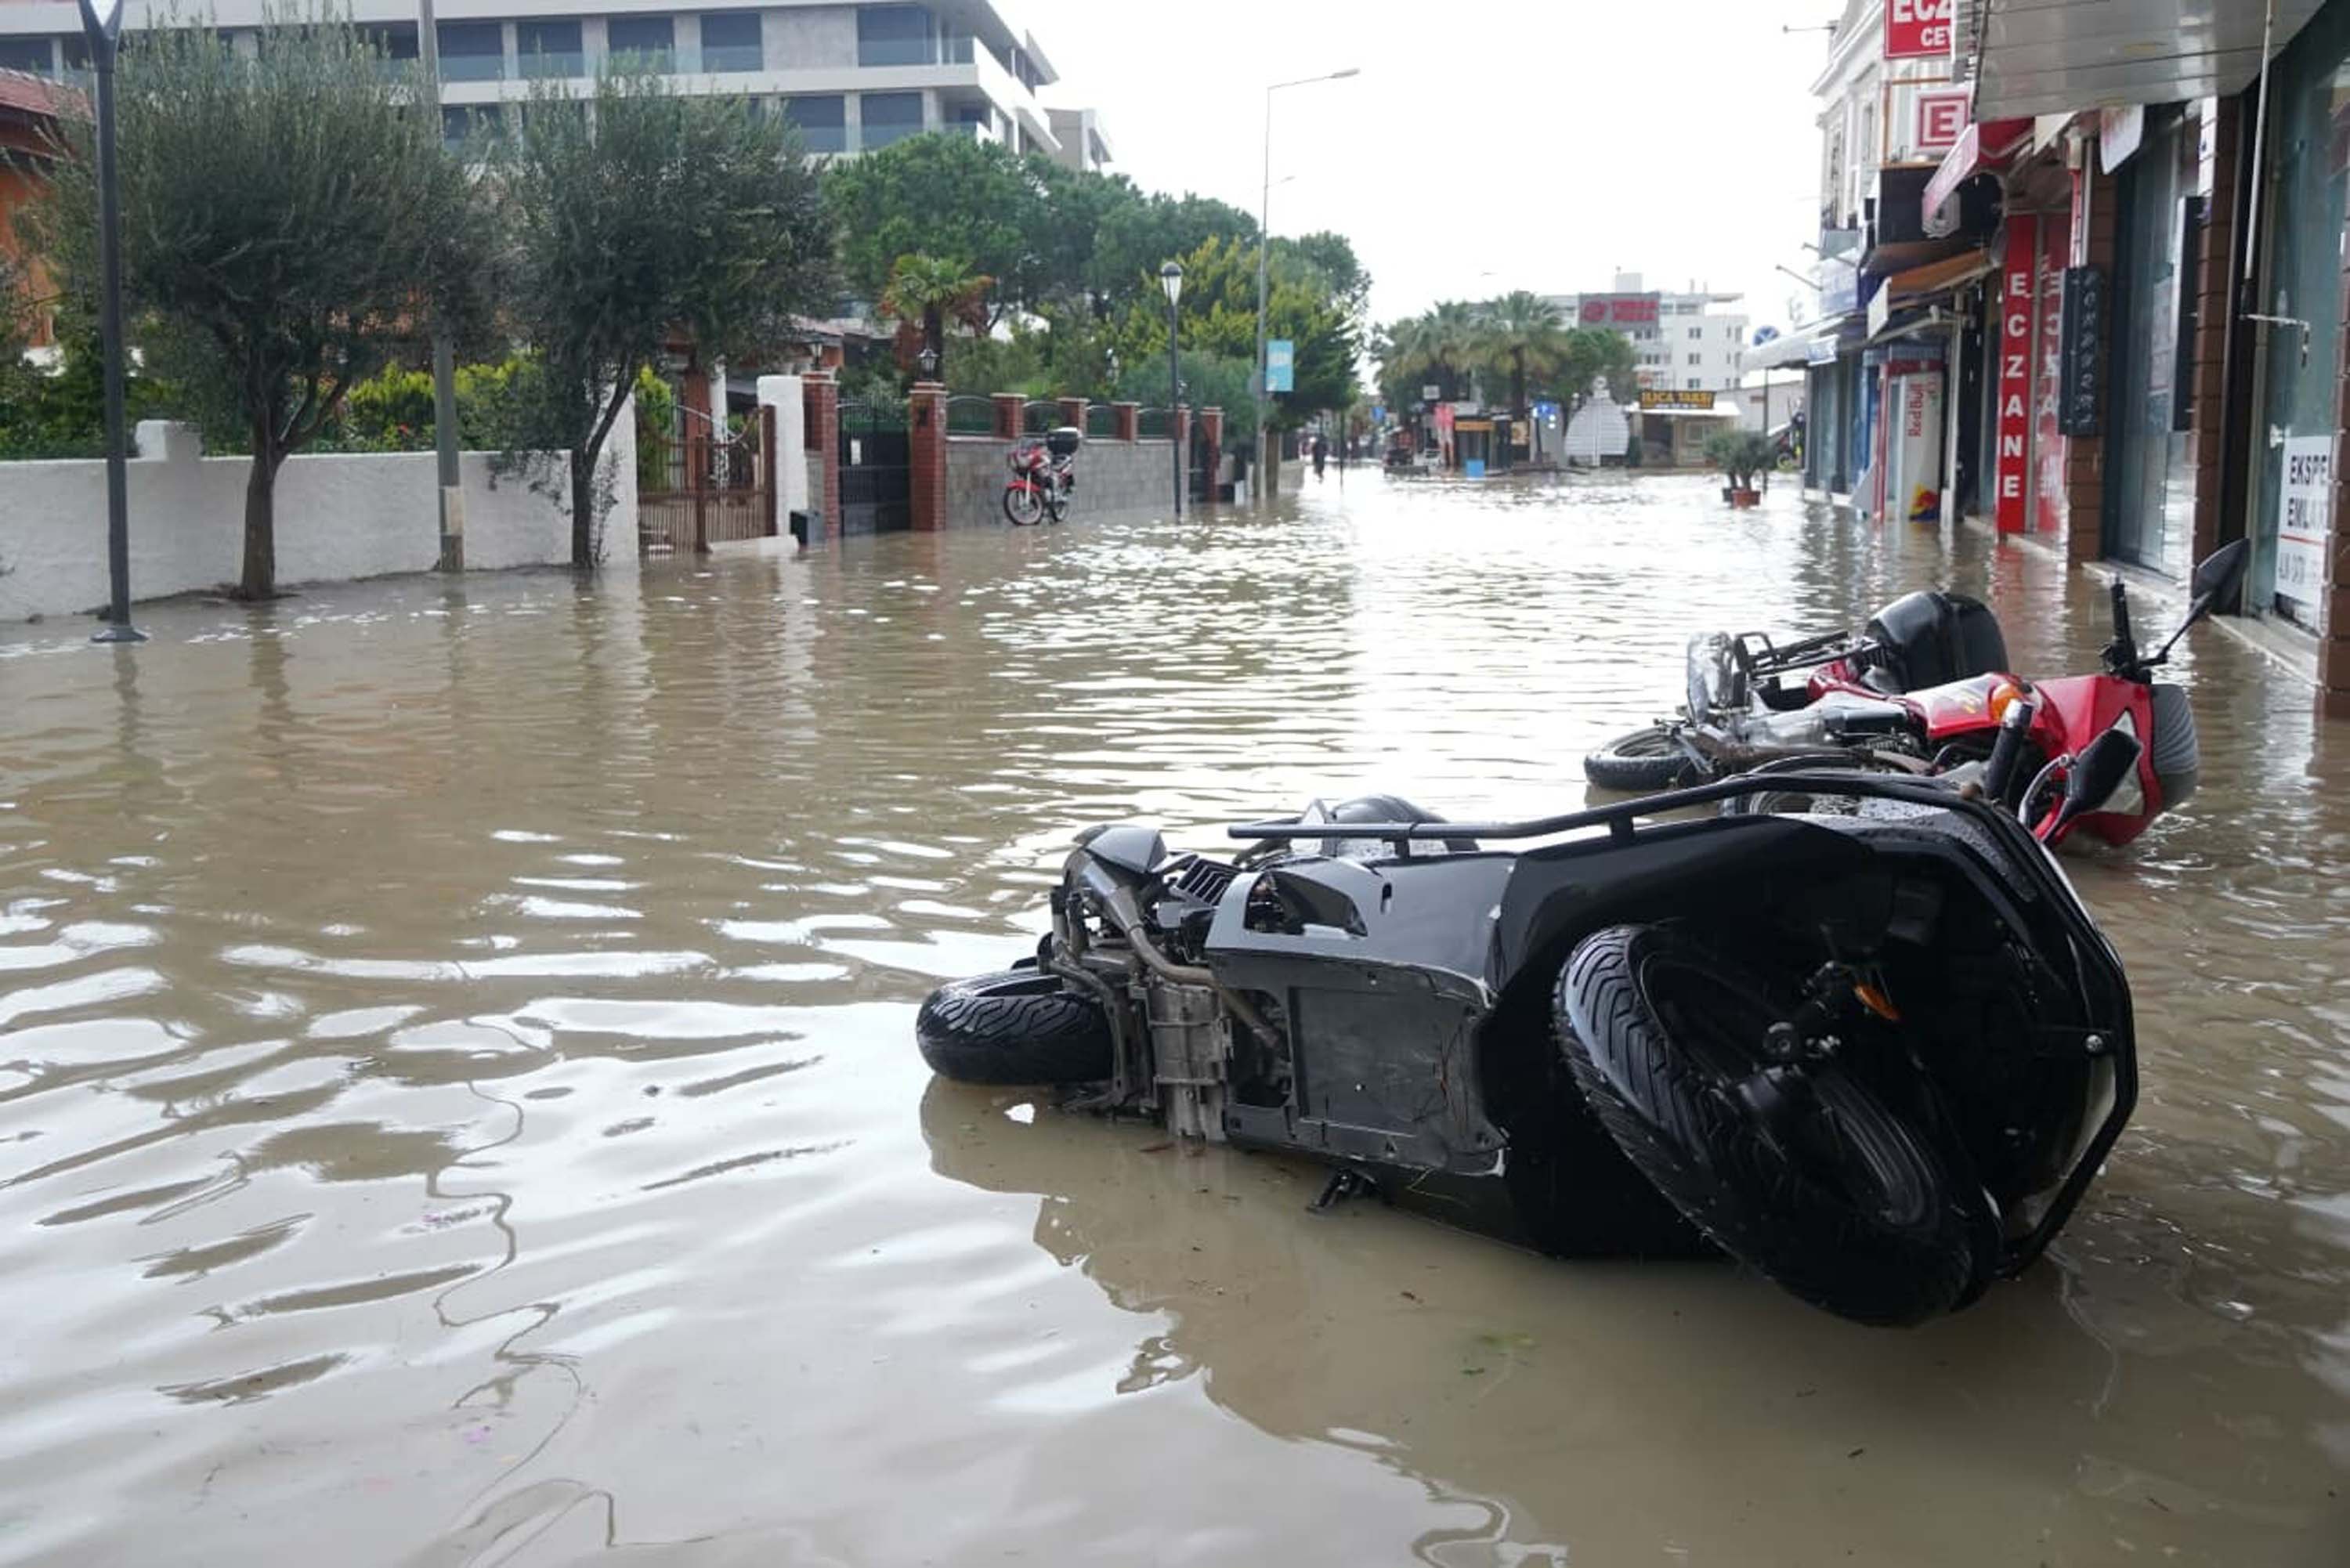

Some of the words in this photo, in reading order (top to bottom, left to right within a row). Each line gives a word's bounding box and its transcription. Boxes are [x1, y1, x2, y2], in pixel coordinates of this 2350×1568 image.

[1930, 104, 1958, 139] E
[1910, 383, 1924, 410] Bull
[2002, 273, 2028, 498] ECZANE
[1907, 410, 1922, 438] Red
[2290, 454, 2330, 486] EKSPE
